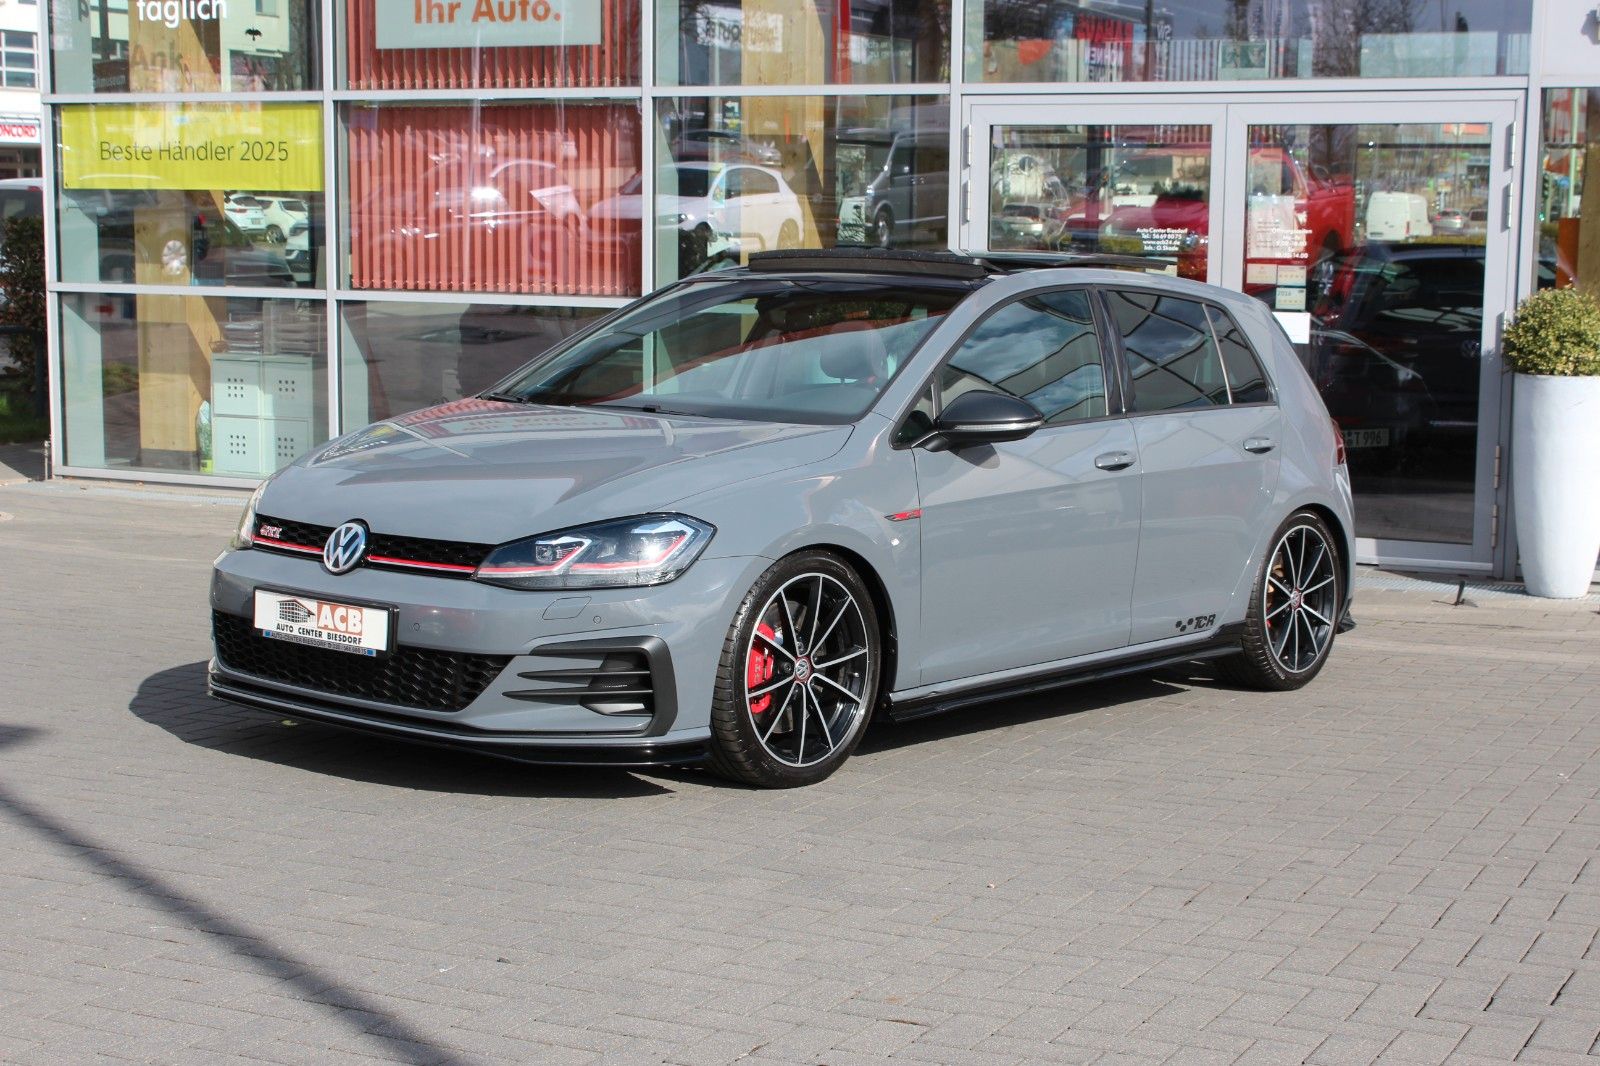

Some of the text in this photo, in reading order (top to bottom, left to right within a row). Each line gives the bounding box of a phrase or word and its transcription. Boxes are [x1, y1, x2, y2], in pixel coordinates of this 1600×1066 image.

[414, 0, 561, 24] Ihr Auto.
[0, 123, 37, 137] NCORD
[100, 140, 289, 162] Beste Händler 2025
[317, 603, 362, 634] ACB
[1194, 613, 1217, 630] TCR
[276, 622, 363, 645] AUTO CENTER BIESDORF
